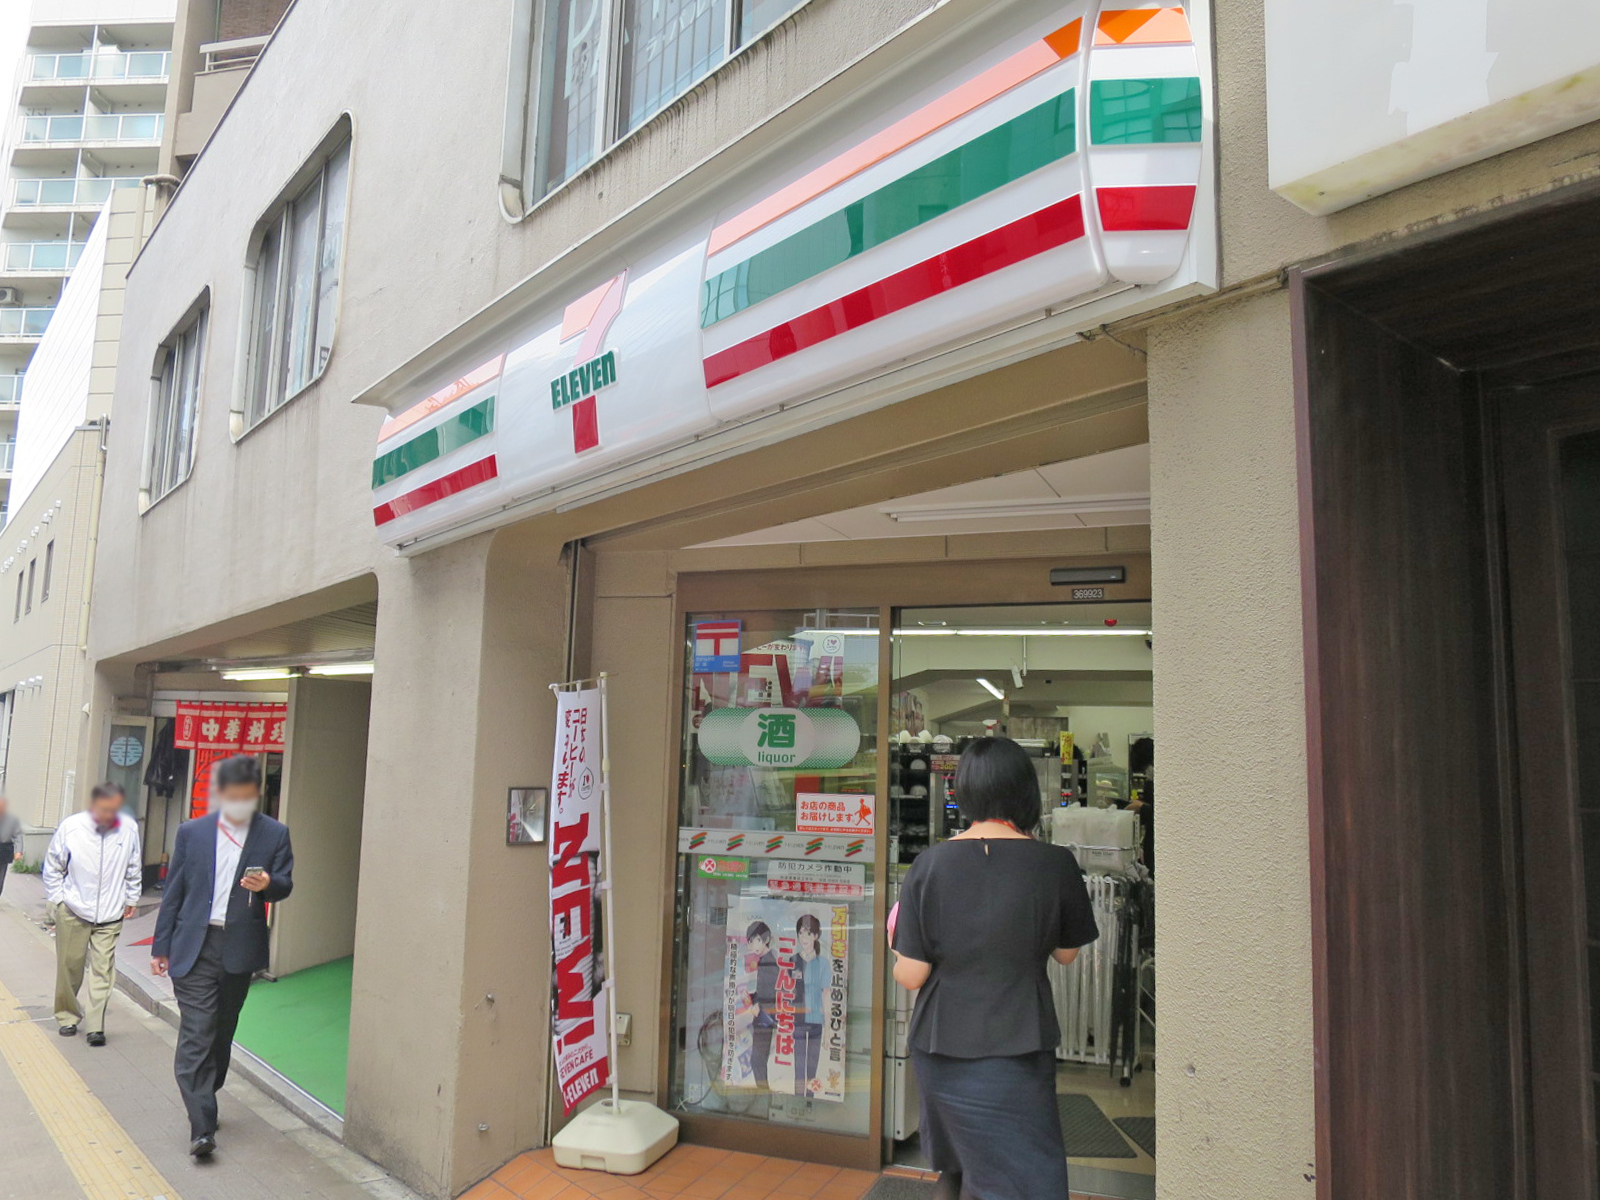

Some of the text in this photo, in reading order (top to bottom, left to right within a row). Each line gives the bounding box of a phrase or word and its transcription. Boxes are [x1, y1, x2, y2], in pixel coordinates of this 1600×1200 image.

[1073, 588, 1103, 599] 369923
[201, 718, 287, 743] 中華料理
[757, 713, 797, 748] 酒
[757, 751, 796, 765] liquor
[801, 800, 846, 812] お店の商品
[777, 861, 852, 873] 防犯カメラ作動中
[553, 812, 595, 1056] NEW!
[829, 905, 848, 1062] 万引きを止めるひと言
